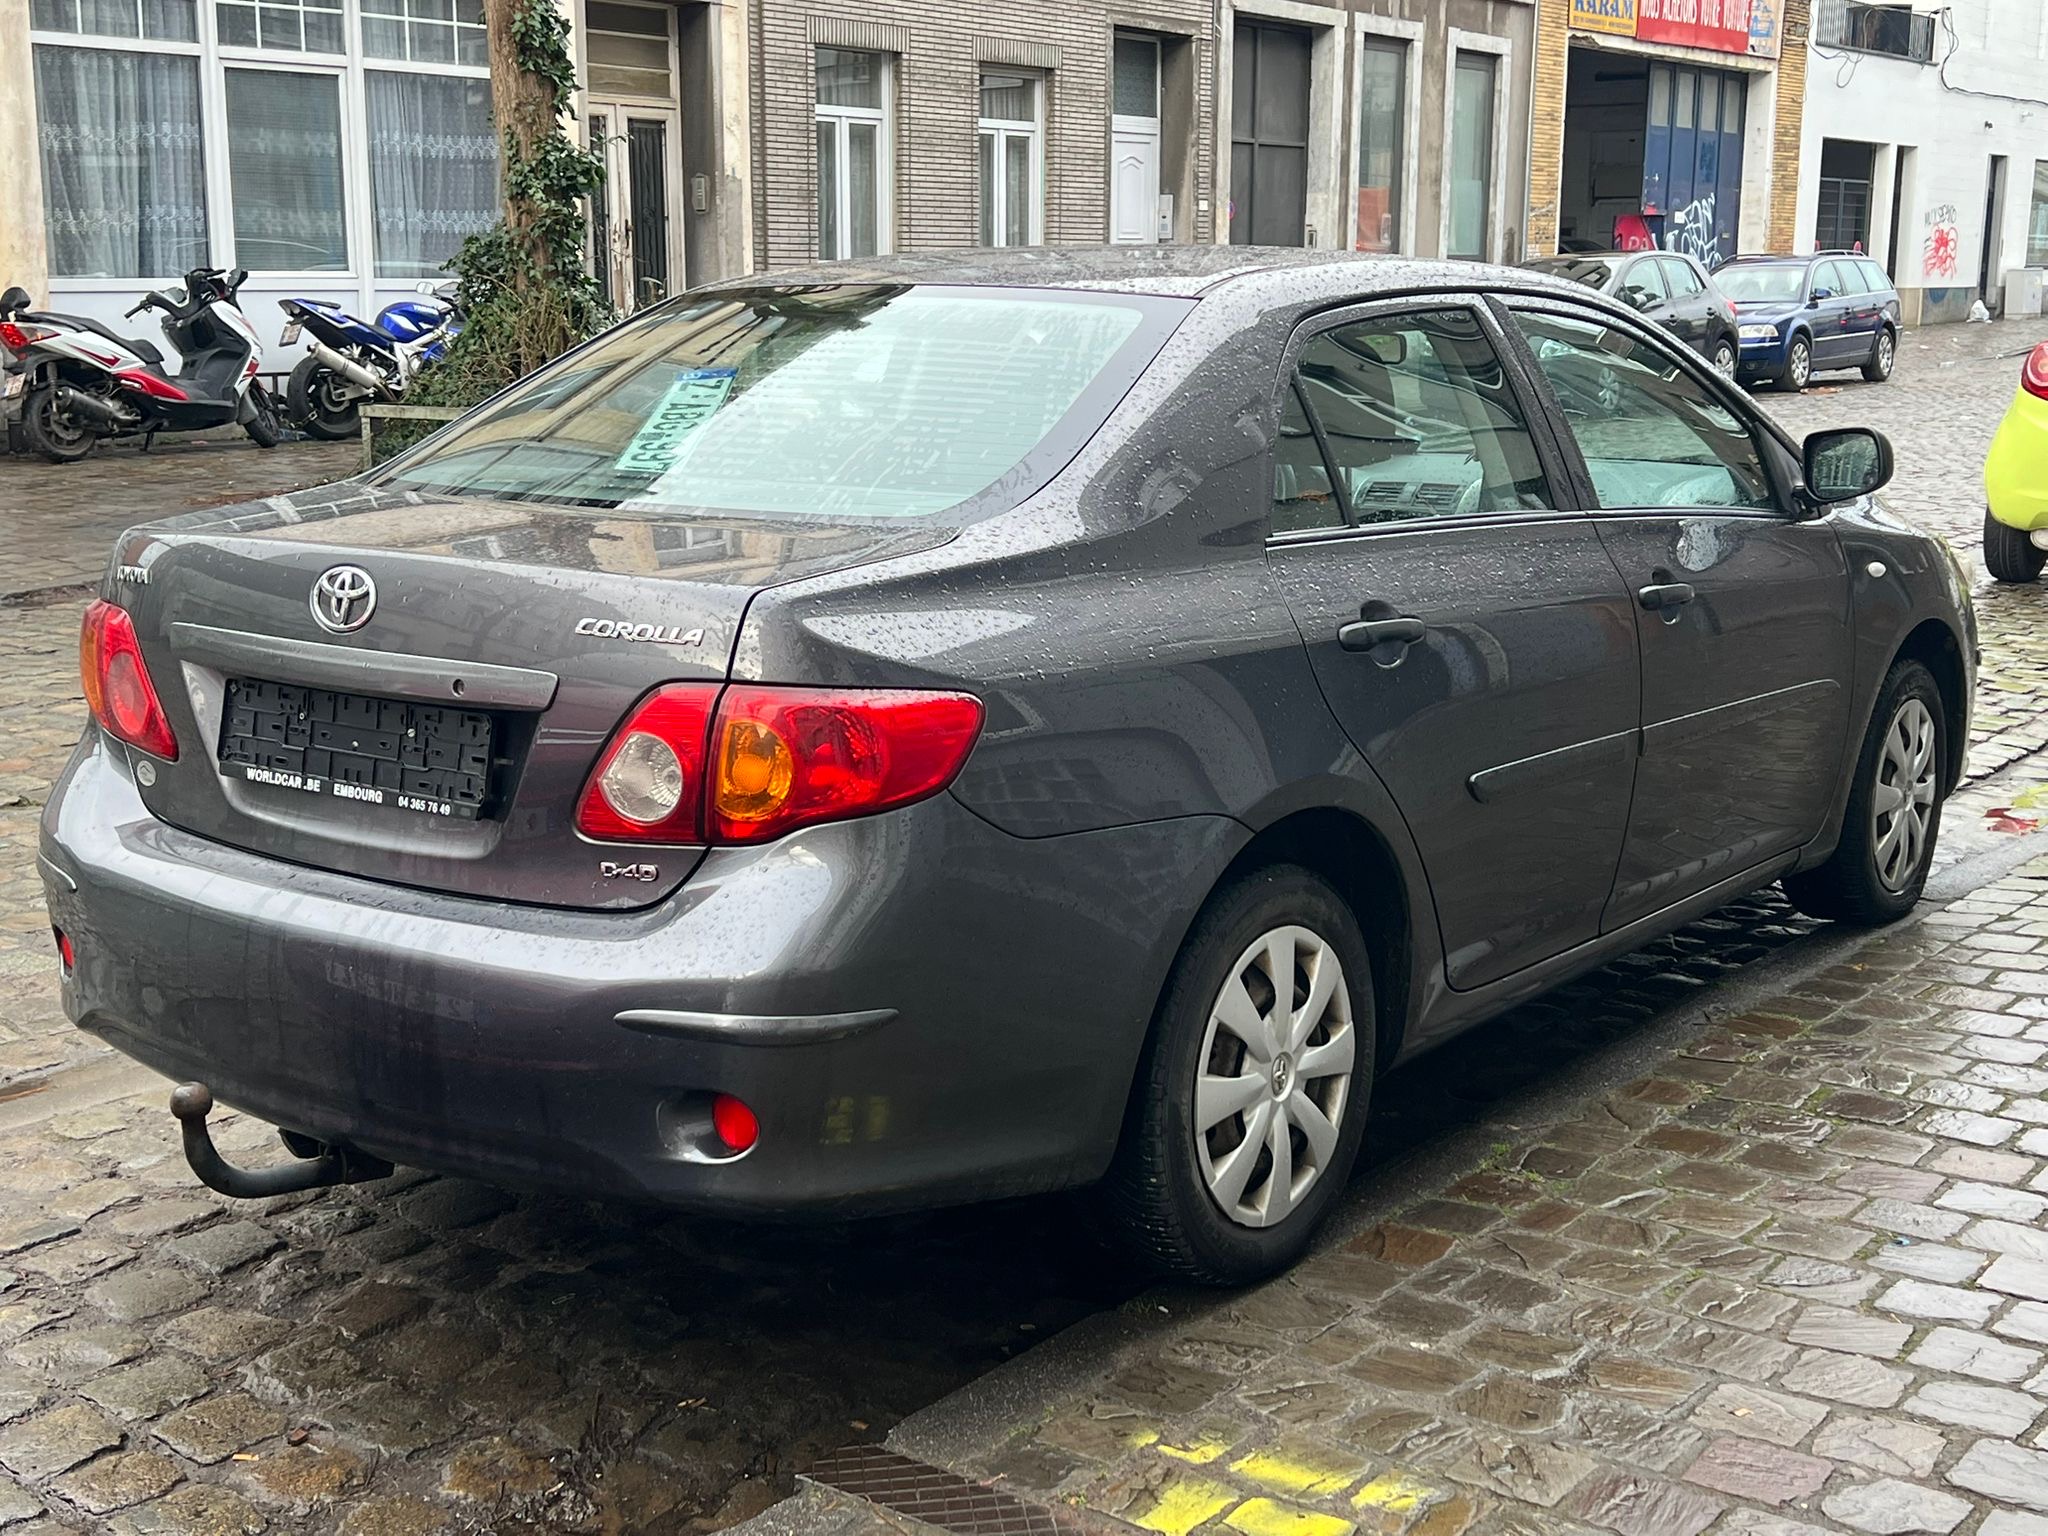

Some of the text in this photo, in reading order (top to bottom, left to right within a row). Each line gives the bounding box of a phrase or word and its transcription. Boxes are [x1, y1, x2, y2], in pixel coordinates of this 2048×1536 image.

[574, 617, 705, 647] COROLLA
[333, 783, 383, 804] EMBOURG
[398, 795, 409, 808] 04
[410, 798, 426, 811] 365
[427, 801, 439, 813] 76
[439, 803, 451, 816] 49
[600, 861, 658, 882] D-4D
